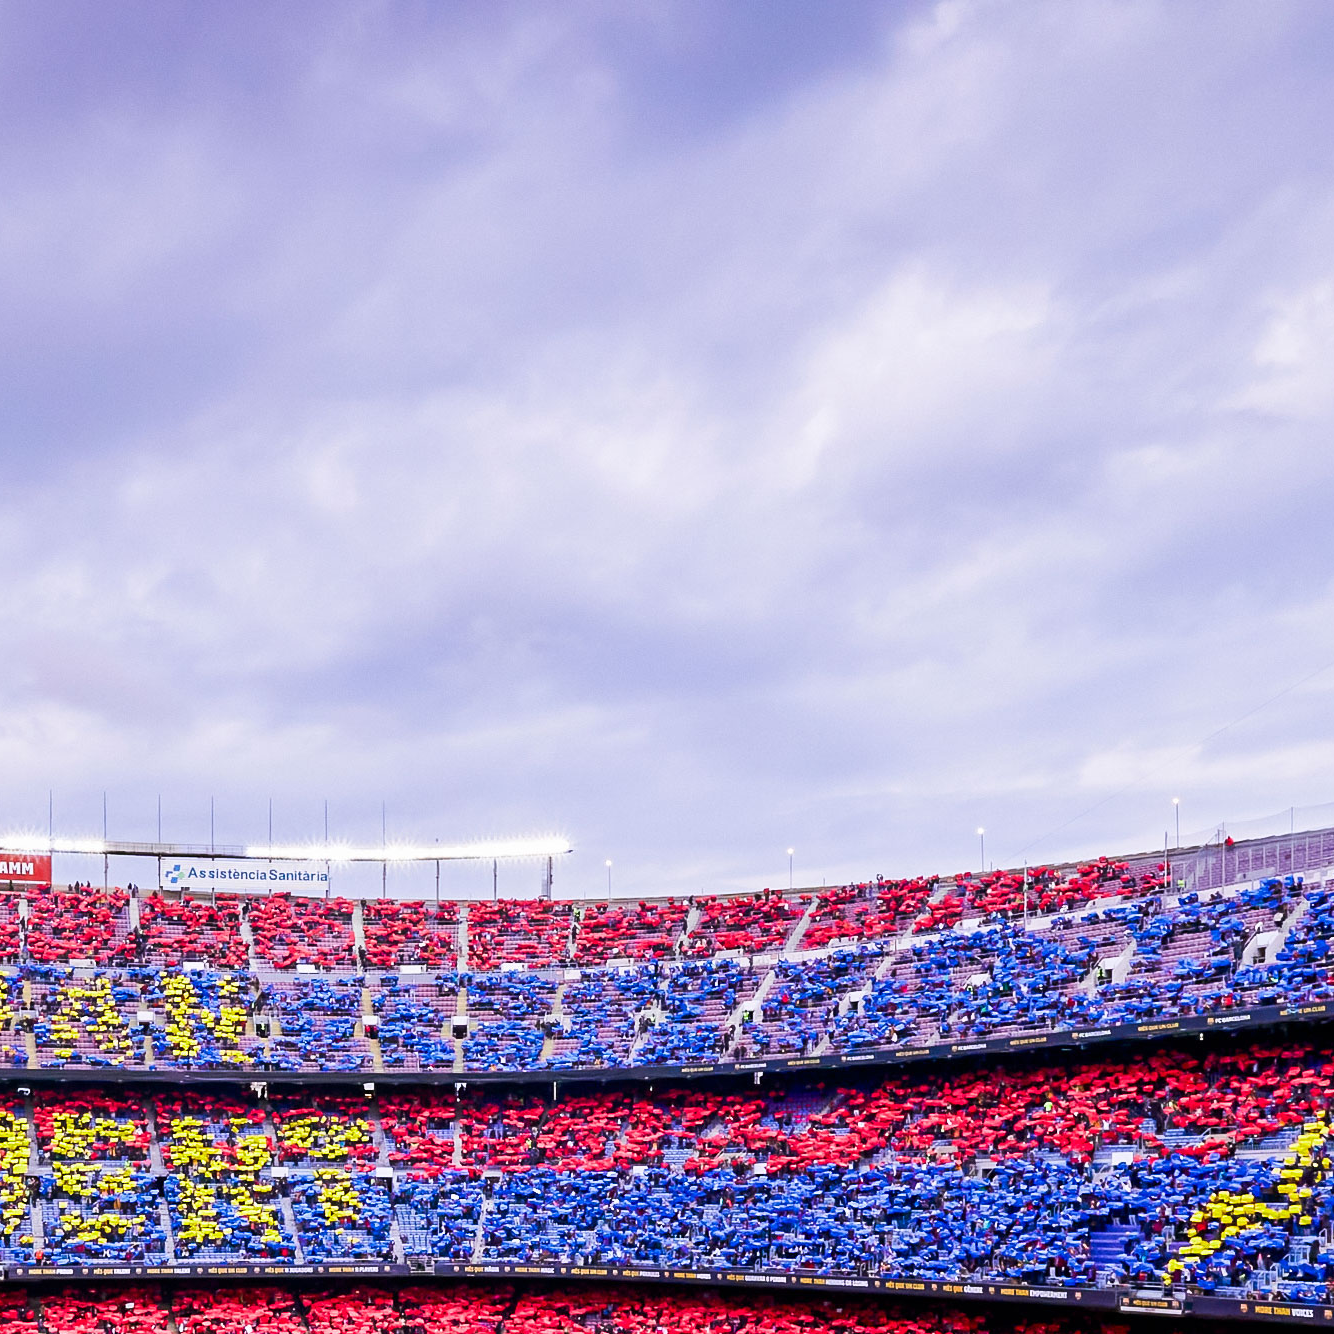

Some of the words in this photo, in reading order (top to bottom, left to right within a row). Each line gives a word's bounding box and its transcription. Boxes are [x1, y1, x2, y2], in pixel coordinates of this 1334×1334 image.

[187, 867, 267, 881] Assistència
[269, 869, 328, 882] Sanitària
[1255, 1306, 1272, 1315] MORE
[1273, 1307, 1291, 1316] THAN
[1291, 1308, 1314, 1317] VOICES
